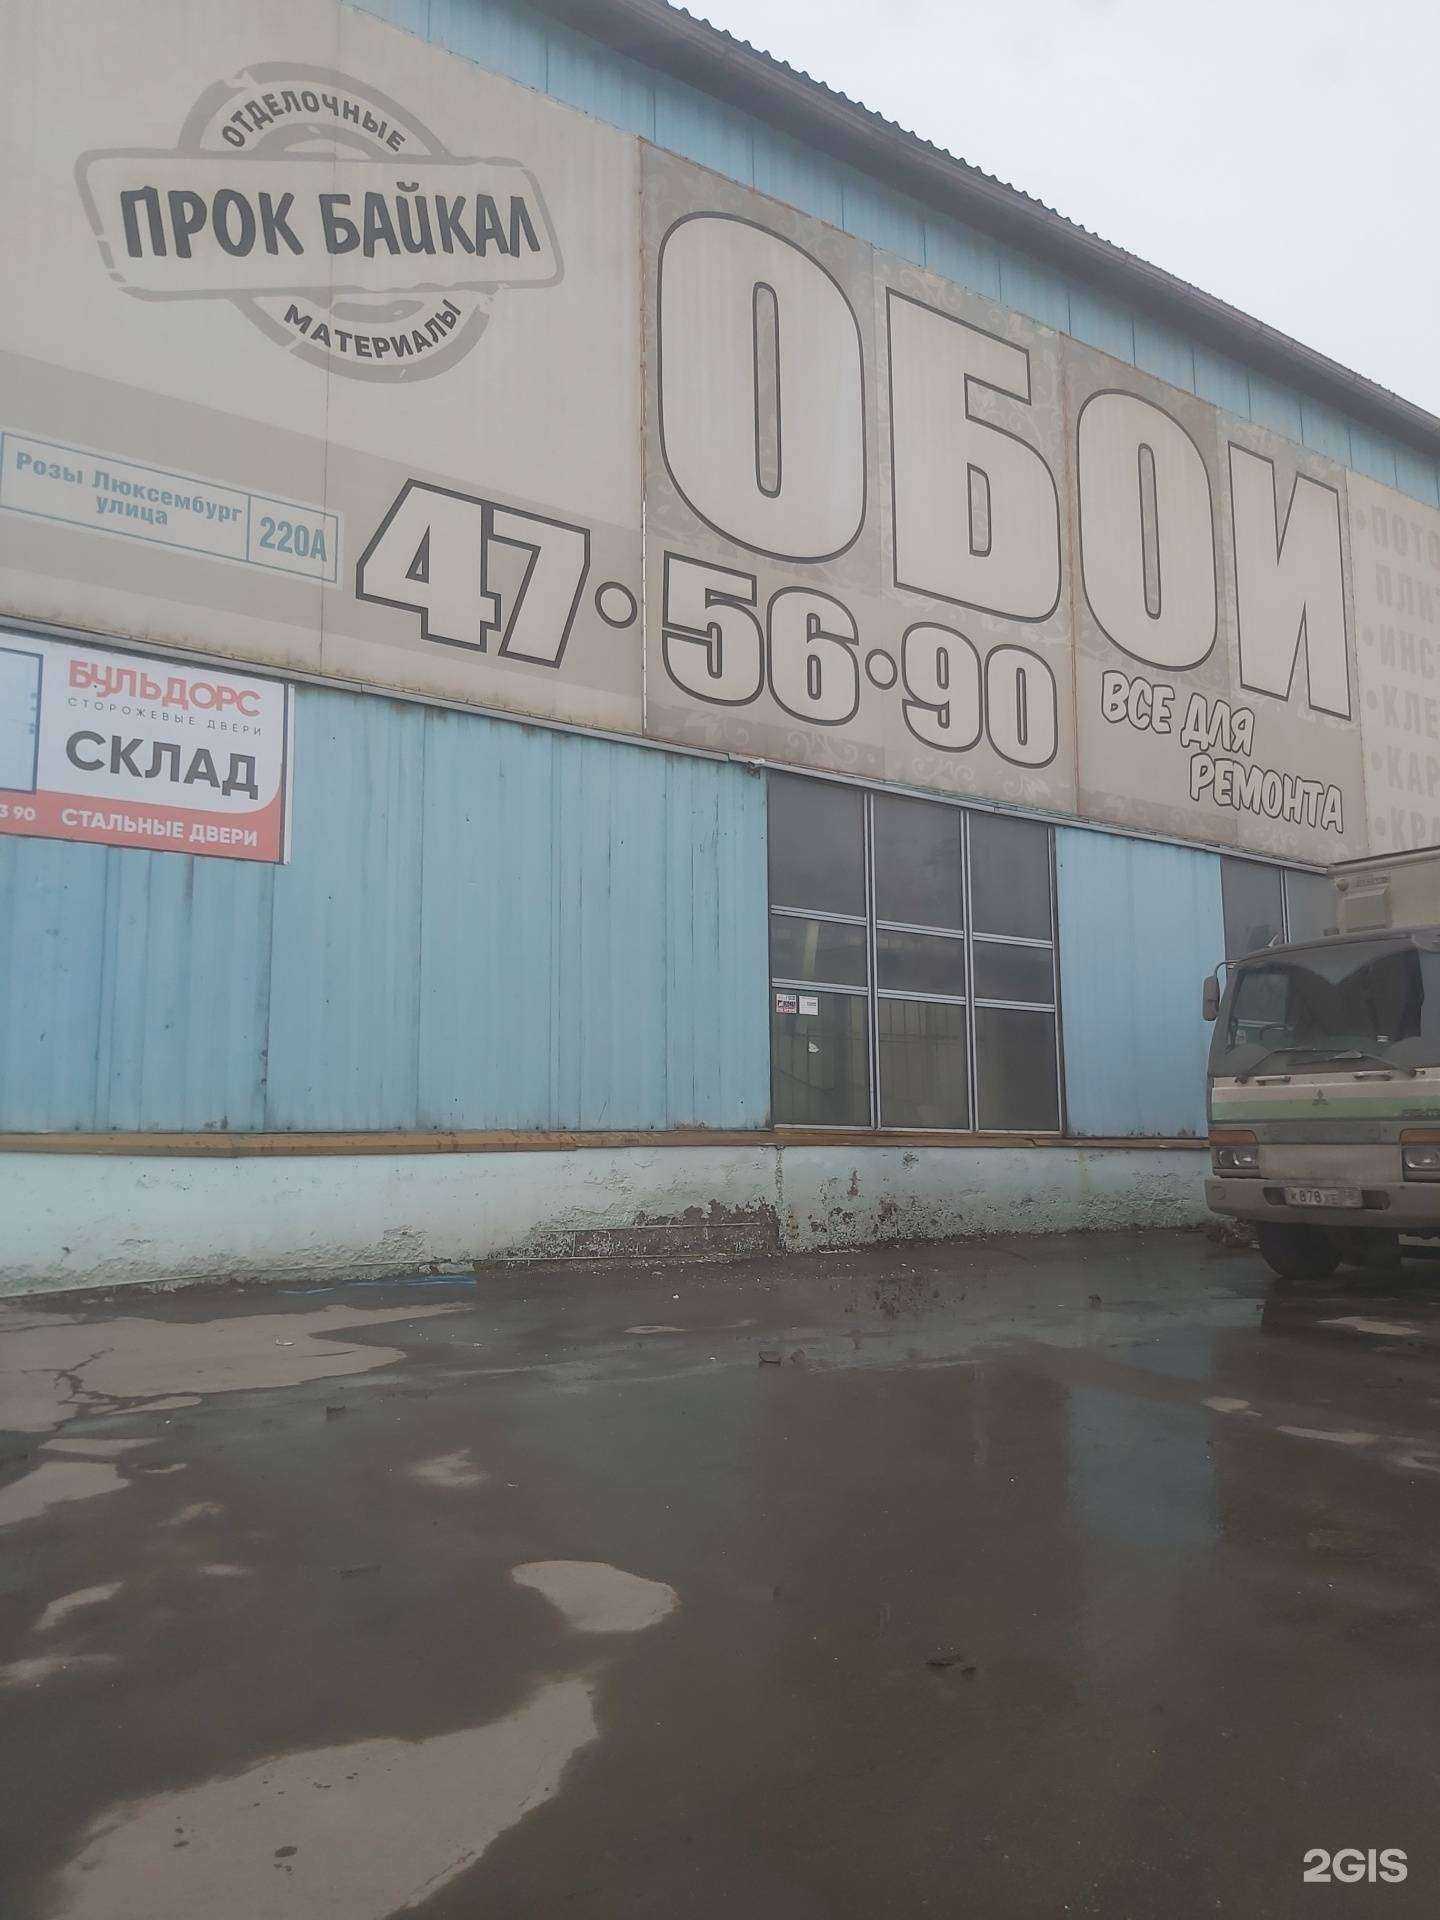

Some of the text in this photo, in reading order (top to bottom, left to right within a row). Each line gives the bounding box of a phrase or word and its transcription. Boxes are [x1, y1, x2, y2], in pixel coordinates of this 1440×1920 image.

[222, 90, 407, 152] ОТДЕЛОЧНЫЕ
[120, 181, 541, 259] ПРОК БАЙКАЛ
[284, 299, 461, 360] МАТЕРИАЛЫ
[16, 451, 243, 523] Розы Люксембург
[658, 211, 1351, 721] ОБОИ
[95, 495, 168, 526] улица
[1380, 623, 1440, 680] ИНС
[68, 697, 262, 737] СТОРОЖЕВЫЕ ДВЕРИ
[69, 659, 261, 717] БУЛЬДОРС
[1101, 670, 1255, 756] ВСЕ ДЛЯ
[66, 730, 259, 800] СКЛАД
[1189, 752, 1344, 834] РЕМОНТА
[13, 806, 35, 821] 90
[61, 808, 258, 846] СТАЛЬНЫЕ ДВЕРИ
